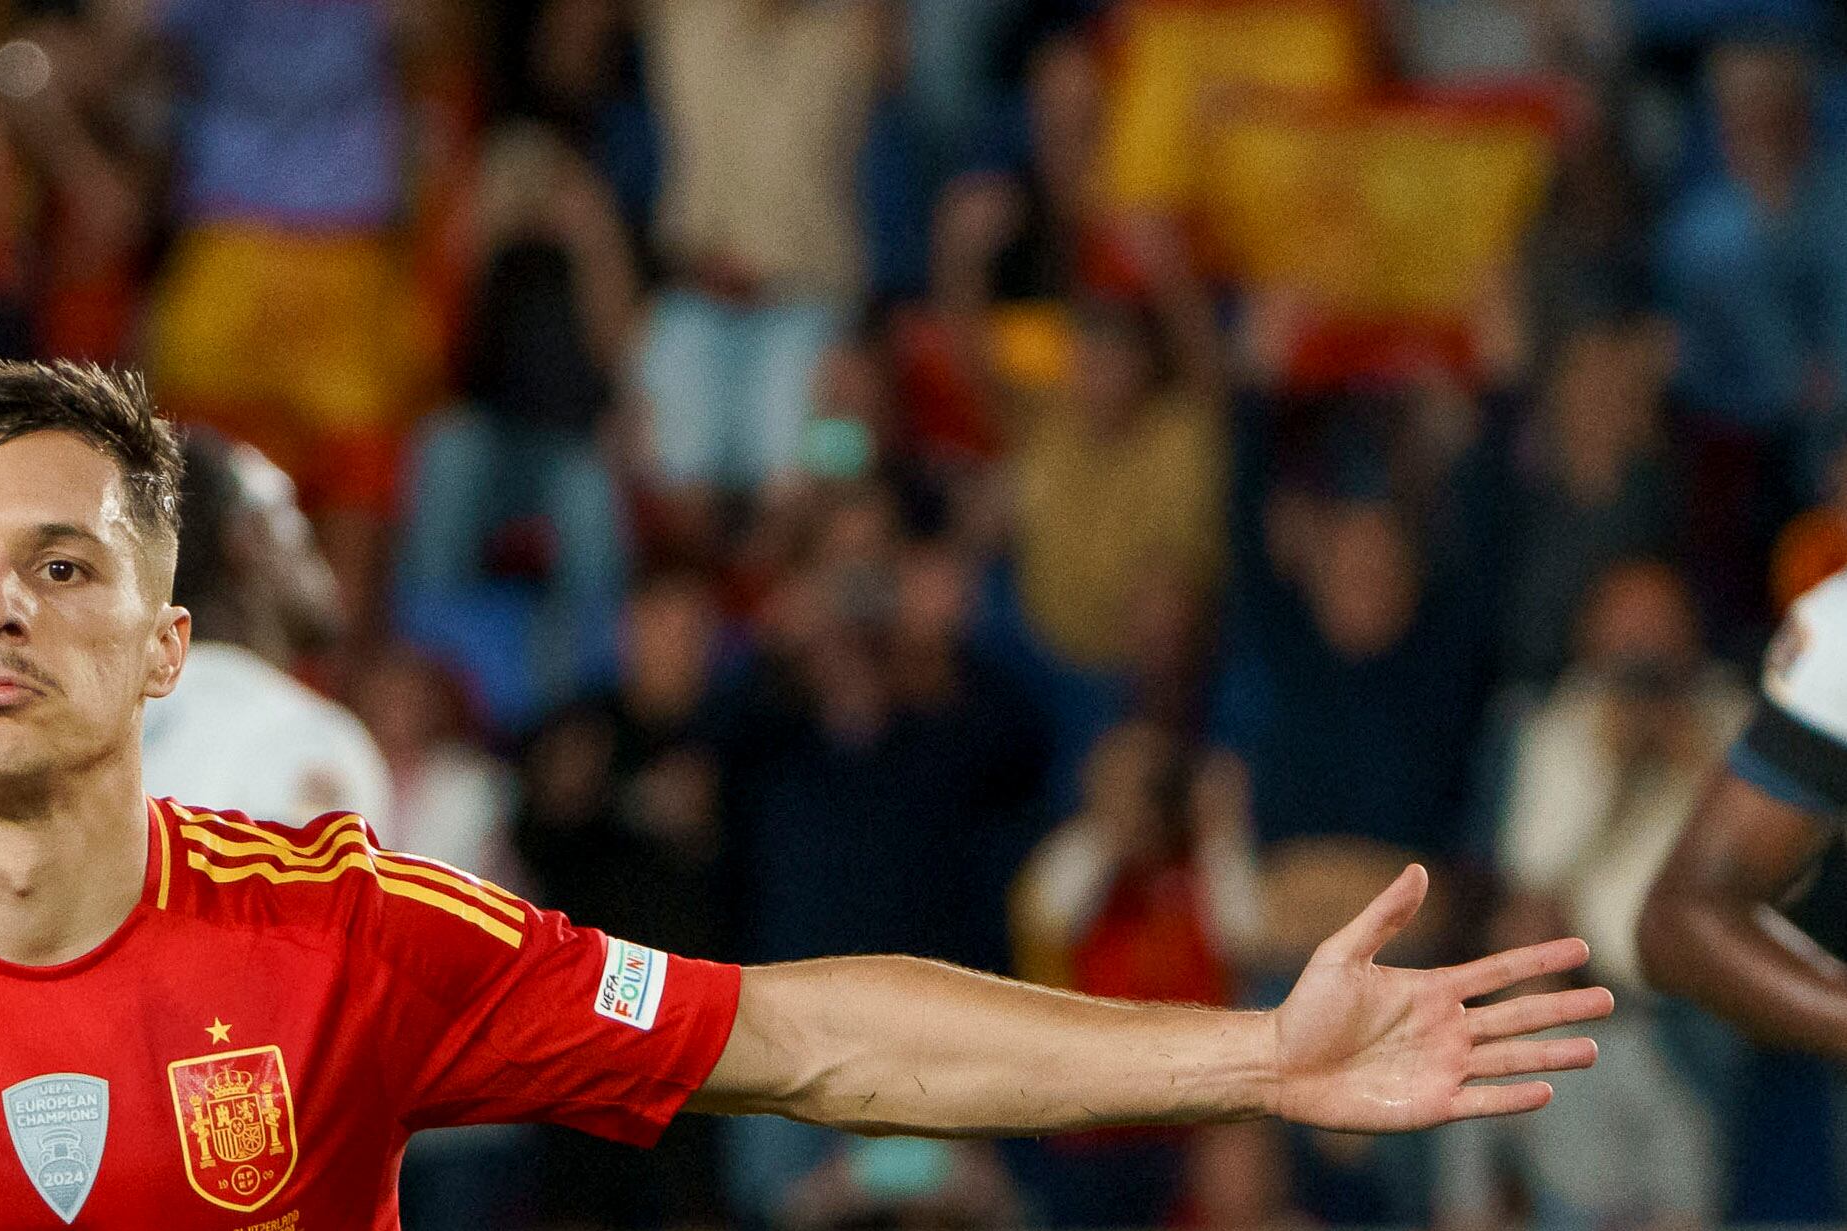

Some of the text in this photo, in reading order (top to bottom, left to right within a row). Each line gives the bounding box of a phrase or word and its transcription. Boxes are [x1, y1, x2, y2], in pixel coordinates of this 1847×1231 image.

[600, 974, 619, 1011] UEFA
[39, 1083, 72, 1096] UEFA
[15, 1093, 99, 1114] EUROPEAN
[16, 1107, 100, 1128] CHAMPIONS
[43, 1171, 85, 1187] 2024
